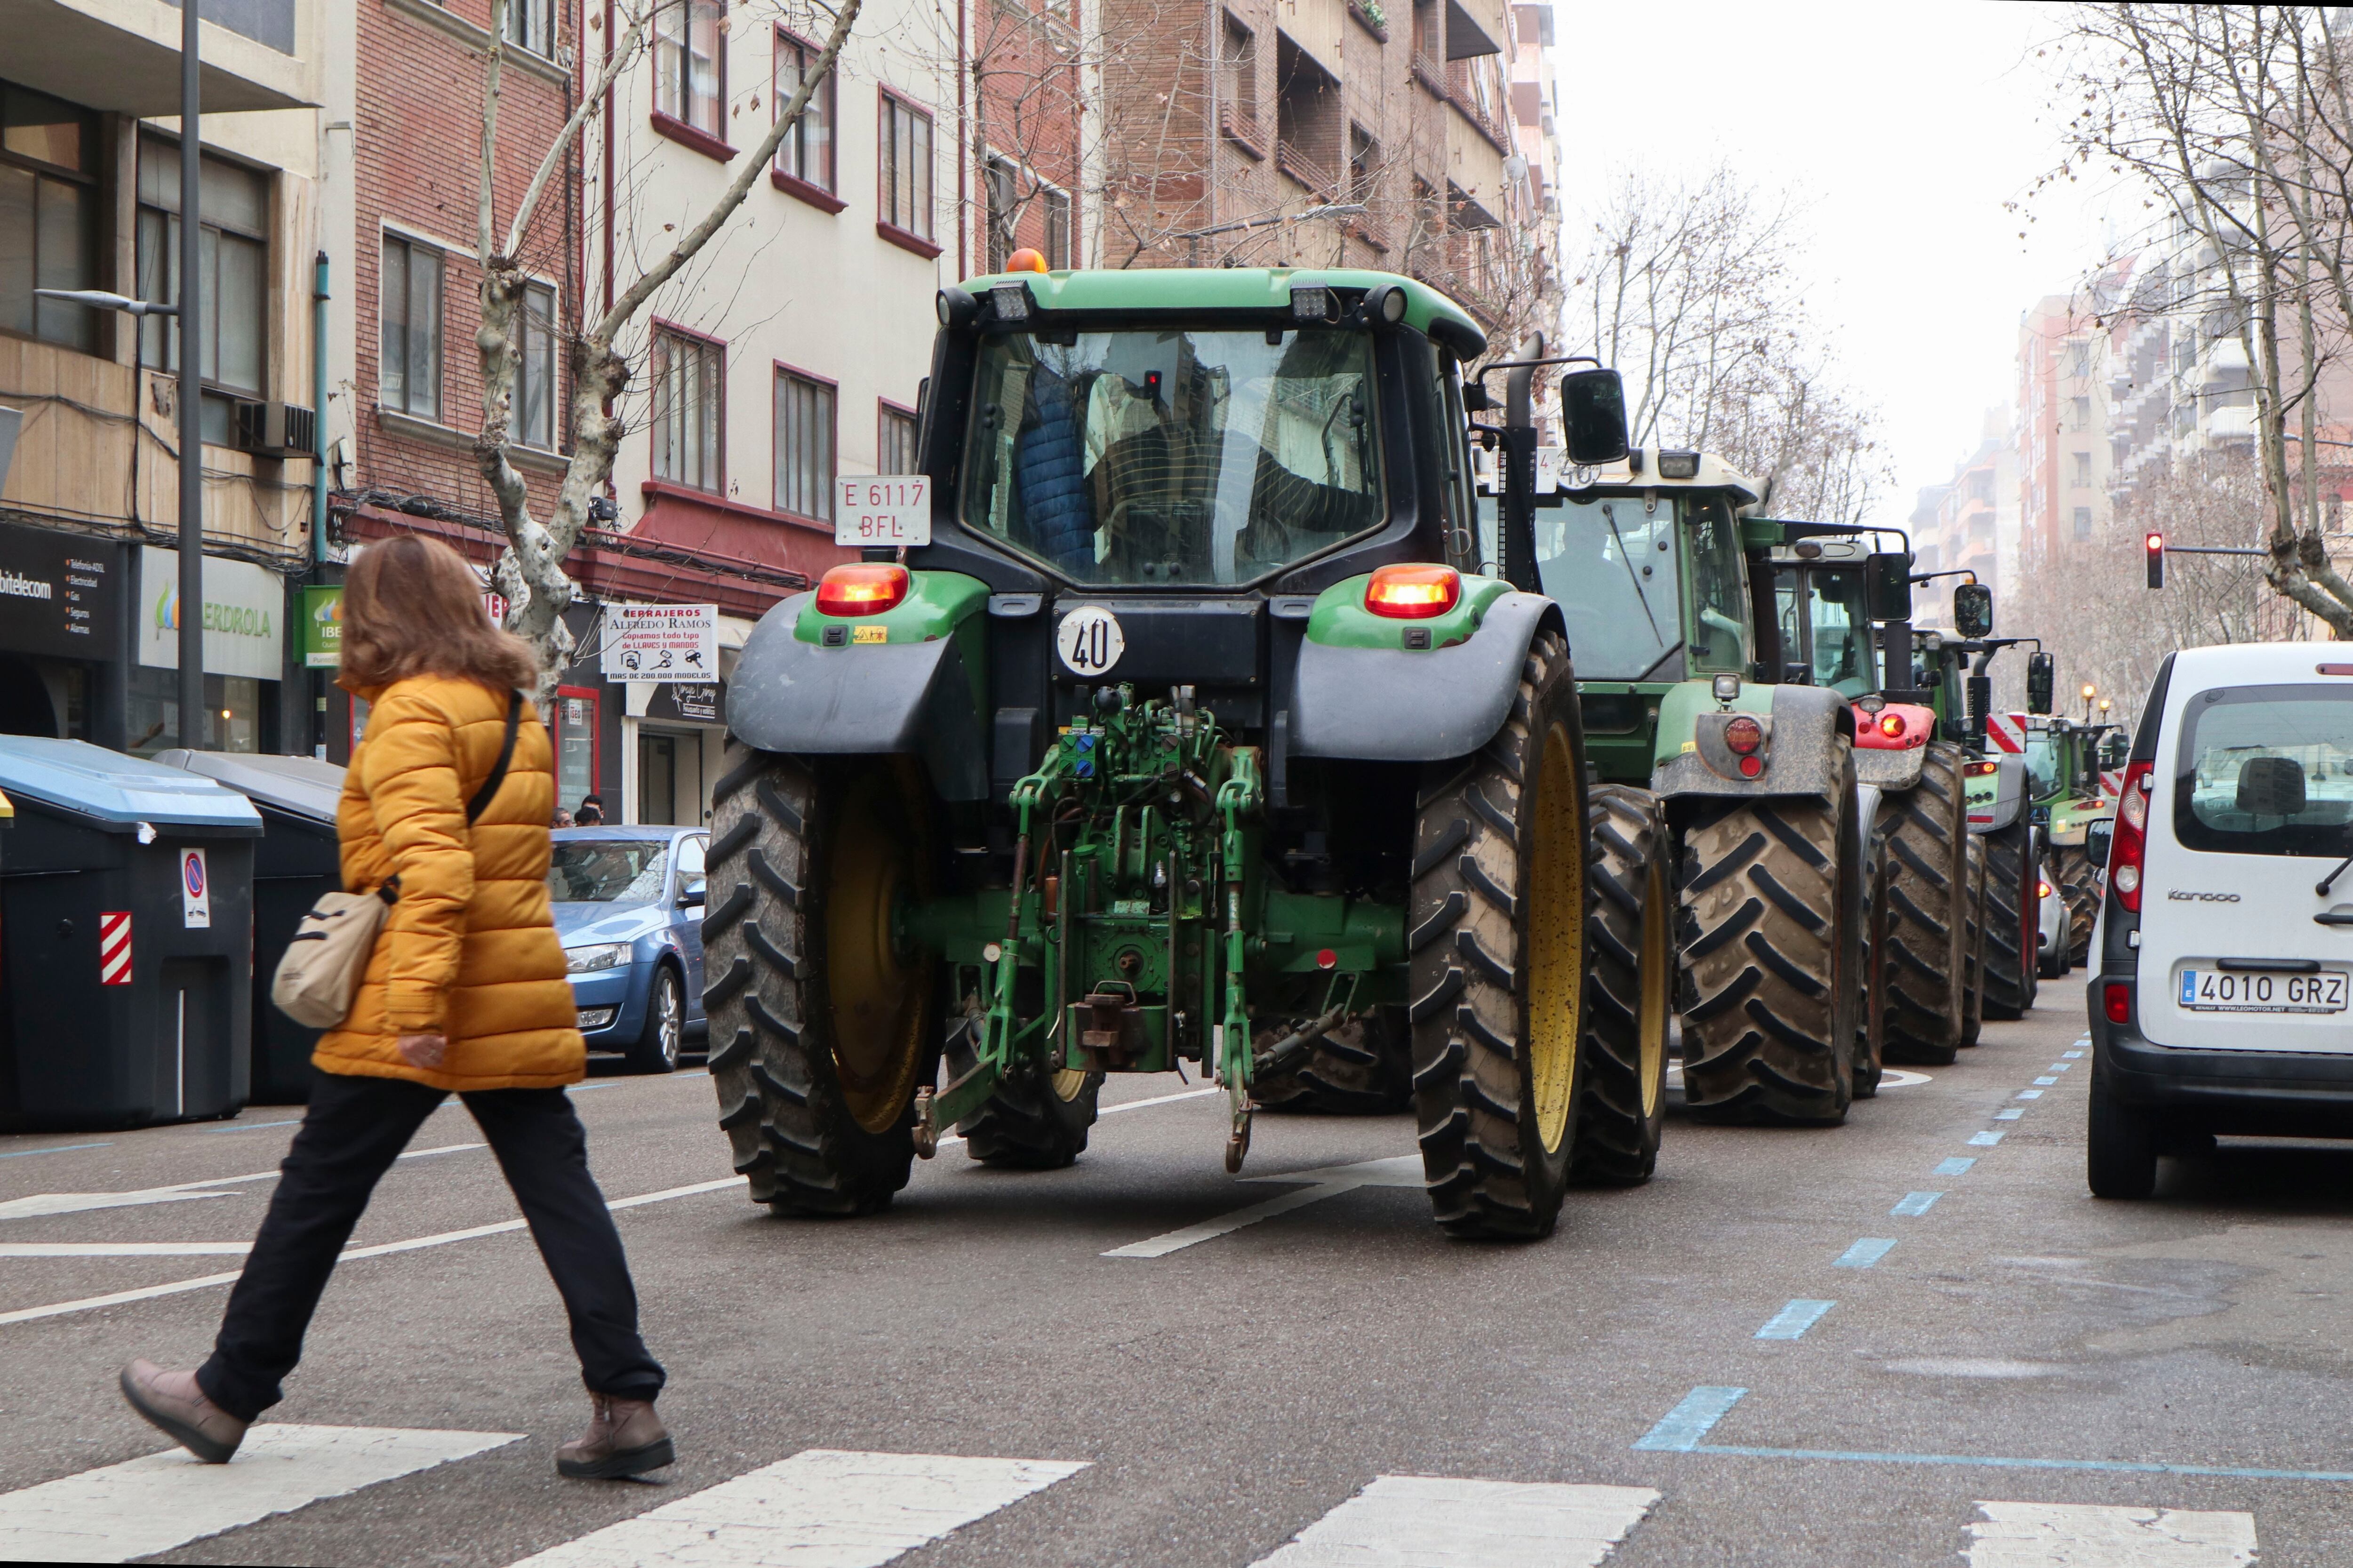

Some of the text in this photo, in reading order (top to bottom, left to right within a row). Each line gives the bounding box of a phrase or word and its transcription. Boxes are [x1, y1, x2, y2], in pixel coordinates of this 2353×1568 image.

[846, 484, 924, 506] E 6117
[862, 516, 903, 537] BFL
[70, 575, 97, 587] Electricidad
[71, 591, 80, 601] Gas
[70, 607, 90, 619] Seguros
[202, 602, 271, 638] ERDROLA
[70, 623, 90, 634] Alarmas
[322, 626, 342, 638] IBE
[683, 632, 699, 640] tipo
[1072, 618, 1107, 669] 40
[2185, 975, 2342, 1004] E 4010 GRZ
